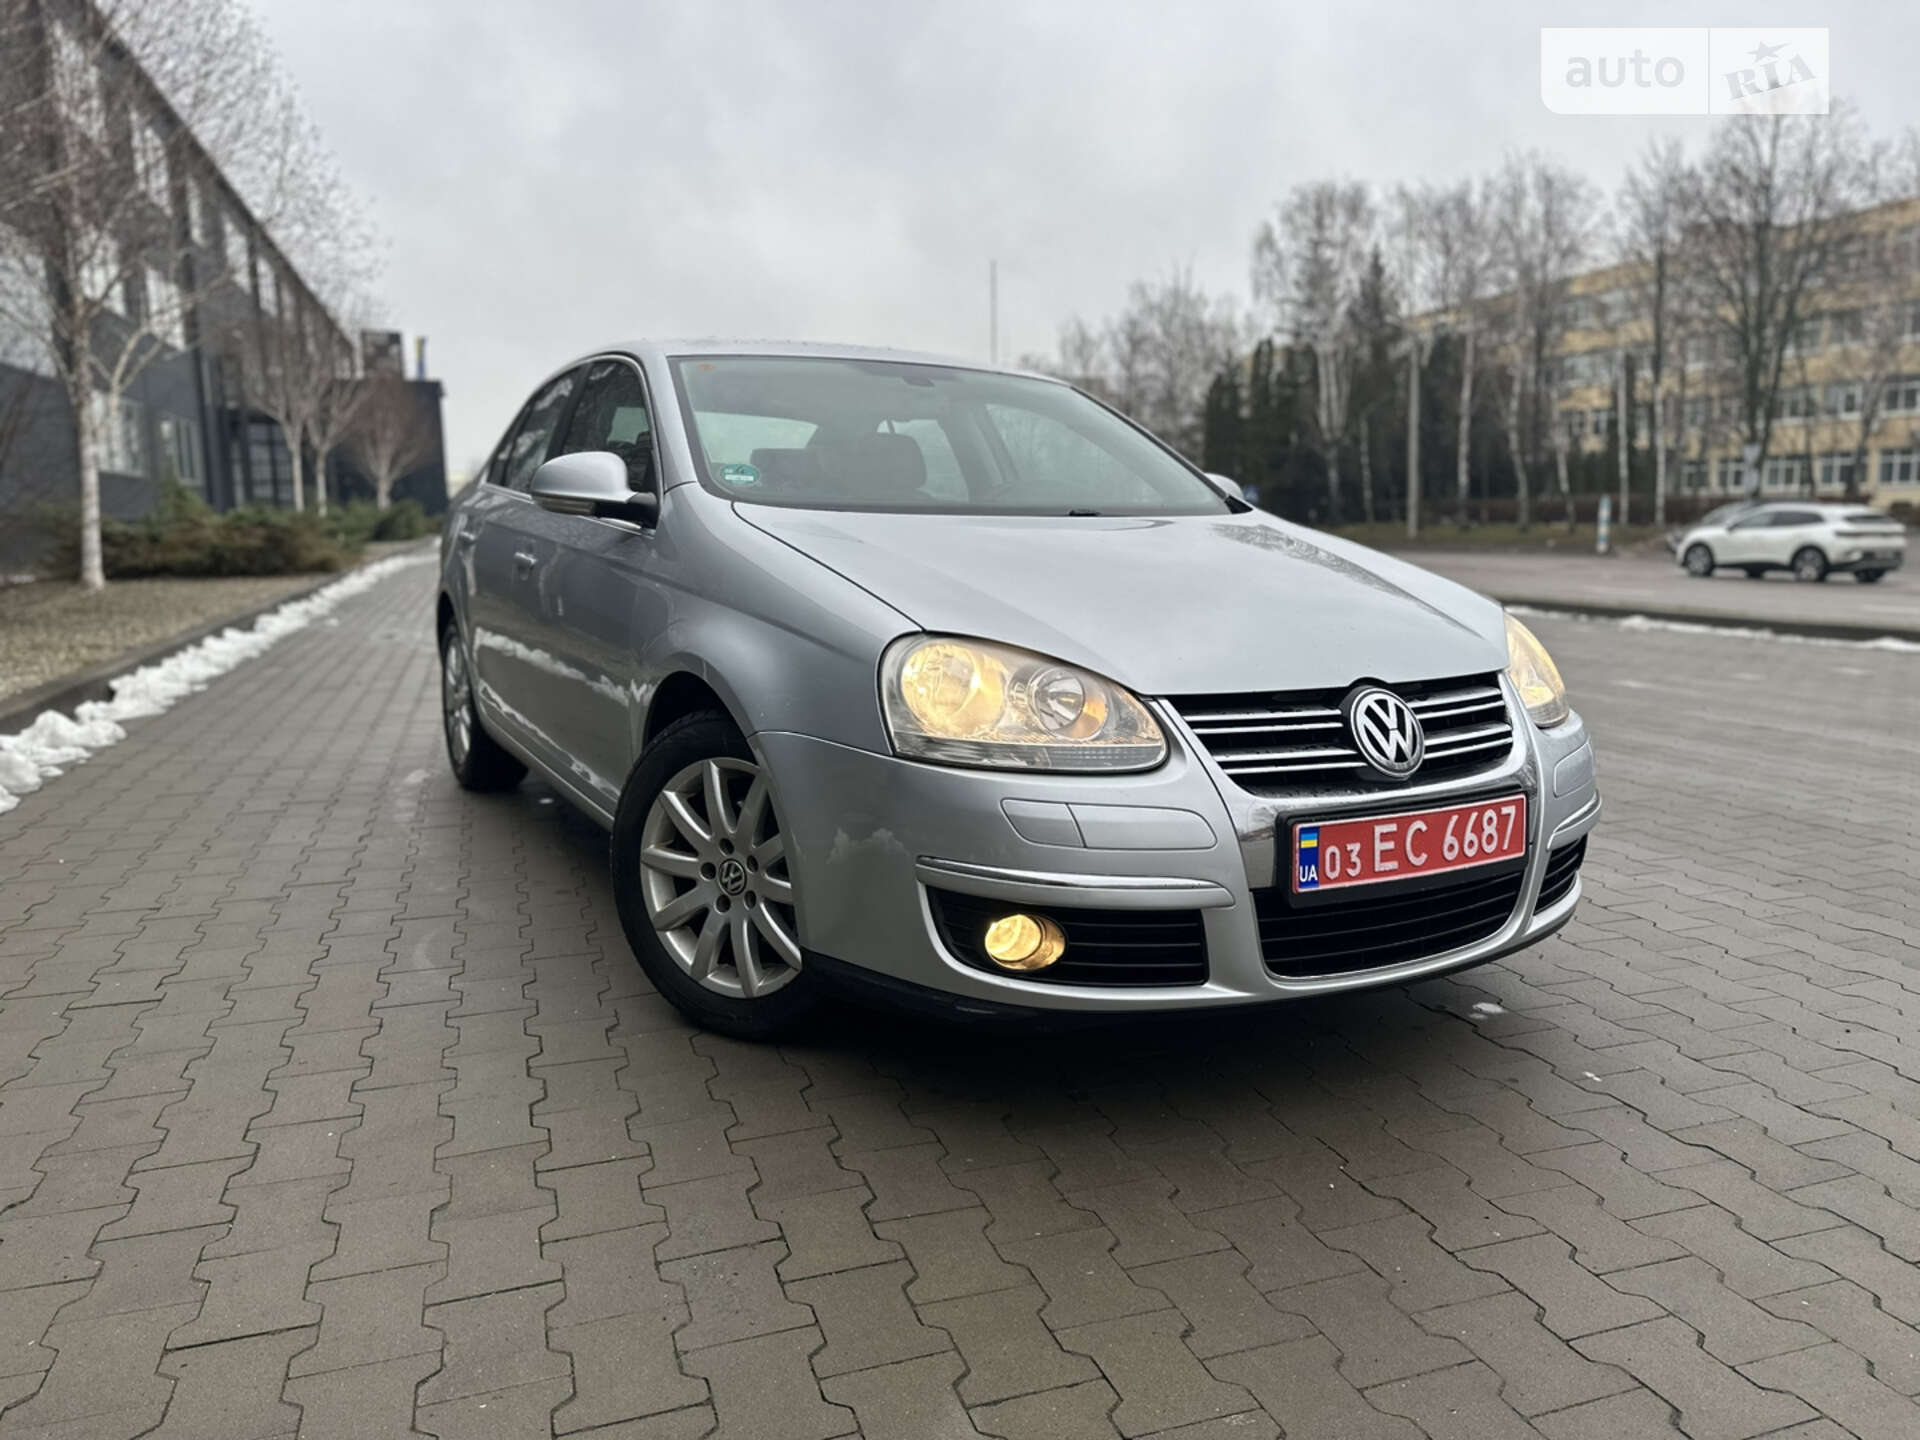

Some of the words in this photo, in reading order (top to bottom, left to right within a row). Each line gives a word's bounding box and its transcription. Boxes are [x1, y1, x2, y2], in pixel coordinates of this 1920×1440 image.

[1355, 691, 1420, 771] VW
[1299, 864, 1318, 882] UA
[1324, 842, 1361, 880] 03
[1374, 820, 1428, 872] EC
[1442, 805, 1516, 861] 6687
